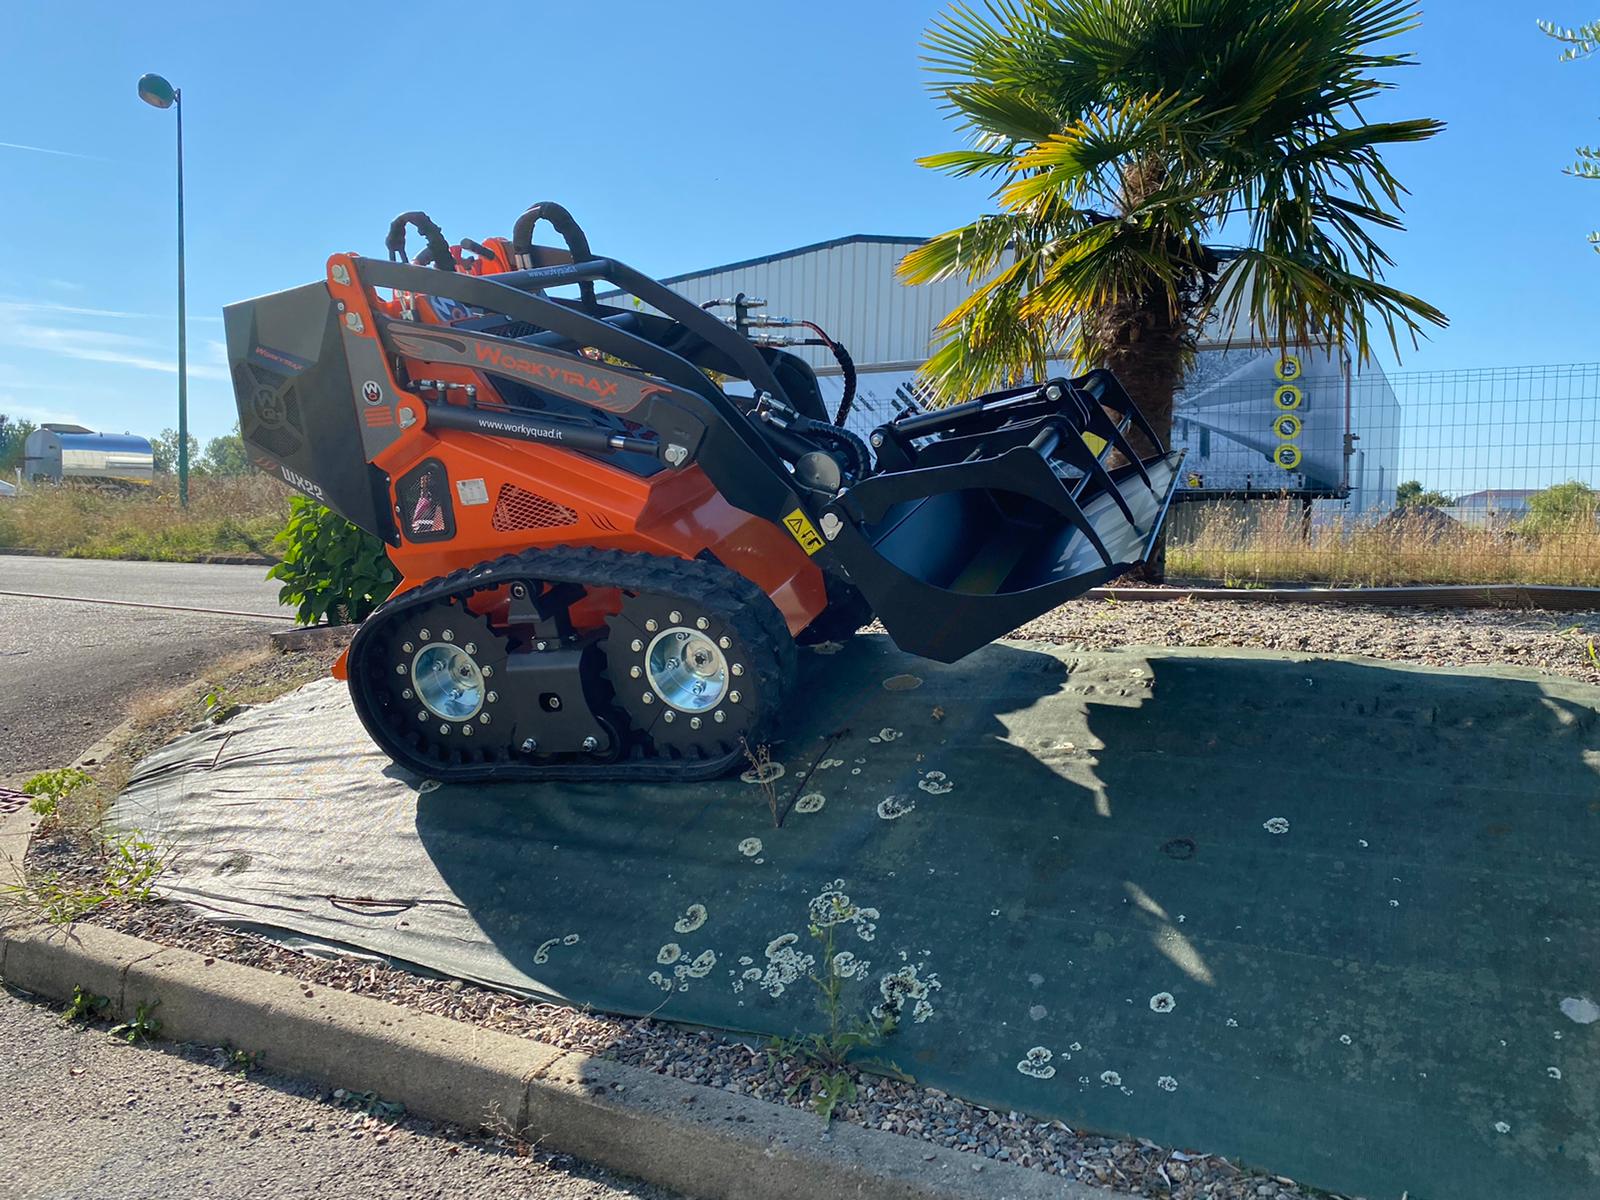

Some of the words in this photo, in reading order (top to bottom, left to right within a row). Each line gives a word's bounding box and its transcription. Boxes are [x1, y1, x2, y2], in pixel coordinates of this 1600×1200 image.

[475, 342, 618, 397] WORKYTRAX
[478, 419, 563, 440] www.workyquad.it
[281, 465, 325, 501] WX22
